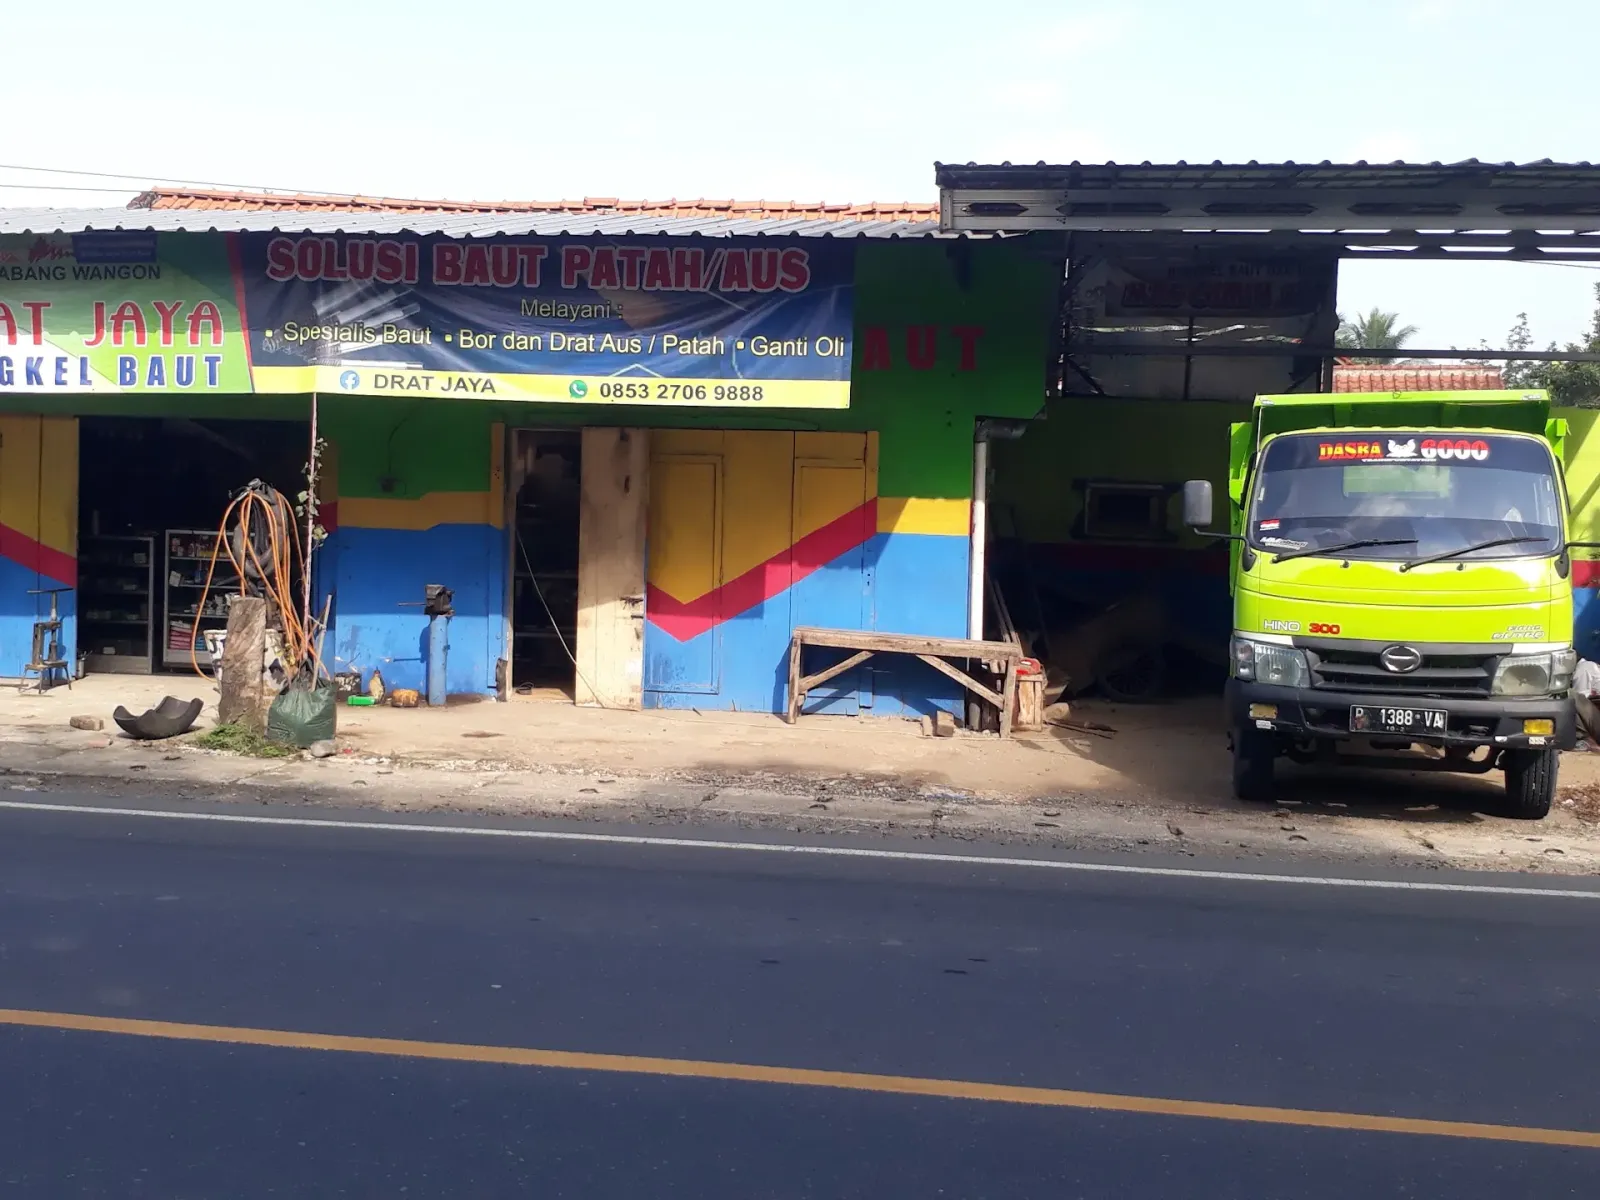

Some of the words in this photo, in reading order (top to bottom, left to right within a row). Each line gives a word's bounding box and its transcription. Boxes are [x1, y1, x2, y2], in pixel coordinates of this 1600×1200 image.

[72, 264, 161, 280] WANGON
[266, 237, 419, 284] SOLUSI
[432, 243, 548, 287] BAUT
[561, 245, 811, 293] PATAH/AUS
[520, 299, 611, 321] Melayani
[84, 300, 225, 347] JAYA
[283, 322, 377, 345] Spesialis
[383, 324, 432, 344] Baut
[459, 330, 497, 349] Bor
[502, 331, 541, 350] dan
[549, 332, 595, 352] Drat
[600, 334, 642, 354] Aus
[663, 335, 725, 355] Patah
[750, 336, 808, 356] Ganti
[815, 337, 845, 357] Oli
[0, 356, 93, 386] GKEL
[119, 356, 223, 387] BAUT
[374, 374, 434, 391] DRAT
[440, 376, 497, 394] JAYA
[600, 383, 650, 399] 0853
[657, 384, 706, 400] 2706
[714, 386, 764, 402] 9888
[1420, 439, 1490, 461] 6000
[1263, 619, 1301, 632] HINO
[1308, 623, 1341, 634] 300
[1380, 708, 1413, 726] 1388
